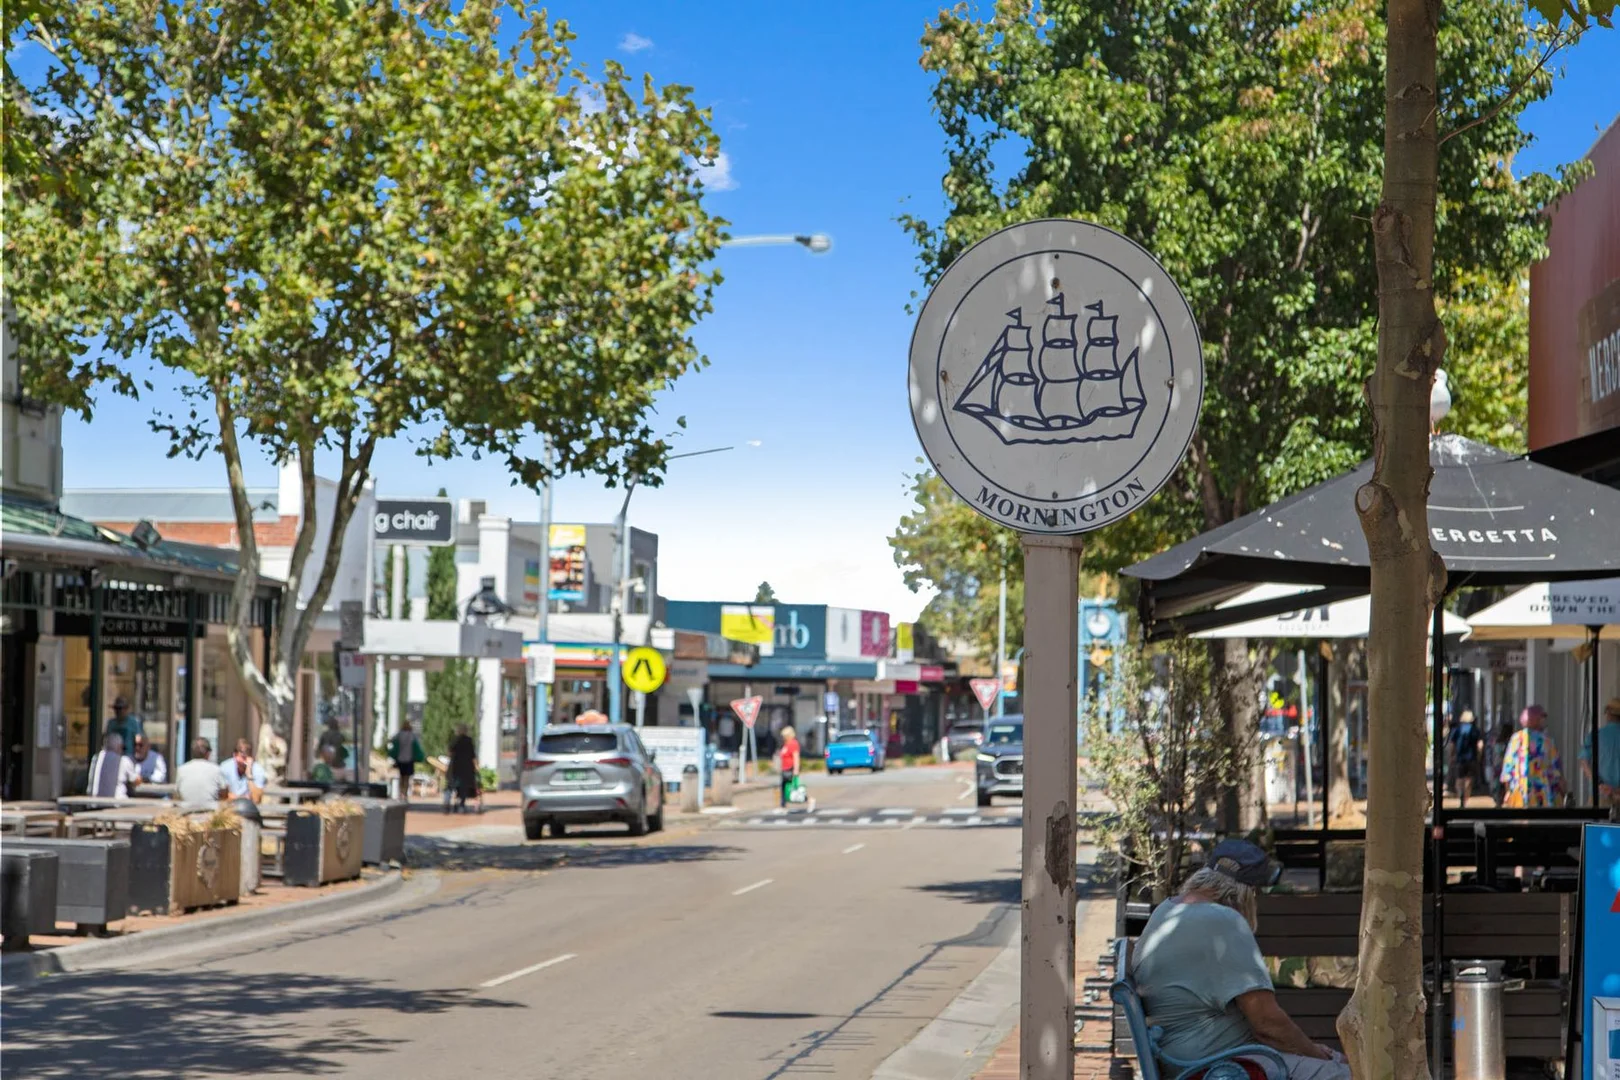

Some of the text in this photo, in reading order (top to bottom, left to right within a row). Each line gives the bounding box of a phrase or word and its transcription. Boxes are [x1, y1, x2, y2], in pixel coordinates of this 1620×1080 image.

[974, 476, 1147, 527] MORNINGTON
[374, 508, 440, 534] g chair
[1431, 527, 1558, 543] ERCETTA
[1542, 594, 1609, 604] BREWED
[1529, 604, 1617, 615] DOWN THE
[101, 618, 138, 633] ORTS
